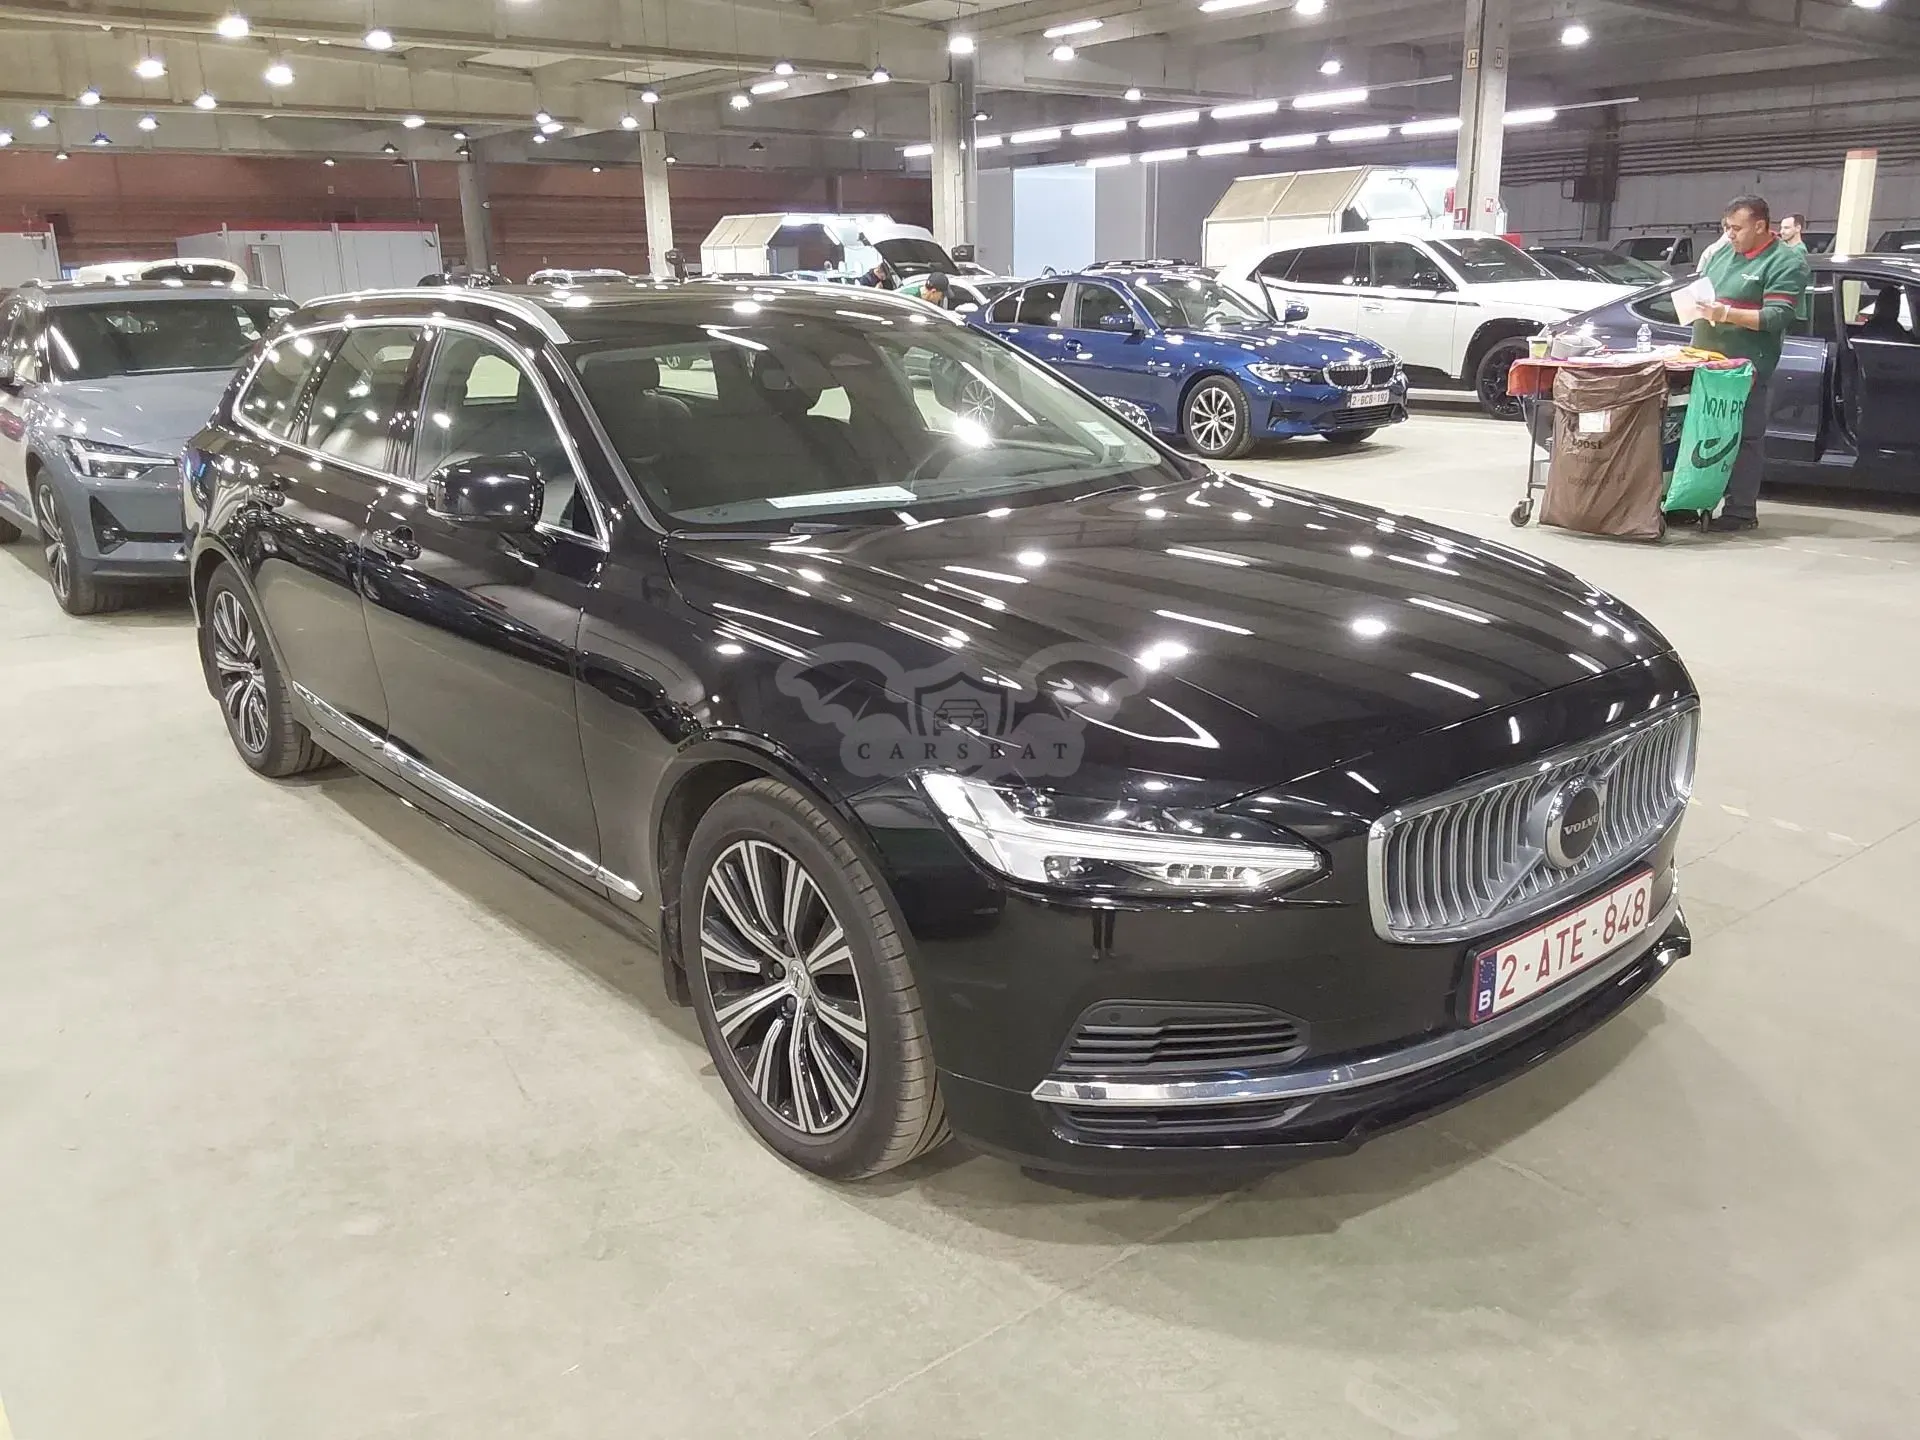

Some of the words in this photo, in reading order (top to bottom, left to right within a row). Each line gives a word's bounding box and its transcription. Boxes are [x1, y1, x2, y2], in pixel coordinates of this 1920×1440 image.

[1470, 52, 1478, 65] H
[1703, 395, 1727, 418] NON
[1498, 887, 1646, 1000] 2-ATE-848
[1478, 989, 1492, 1012] B
